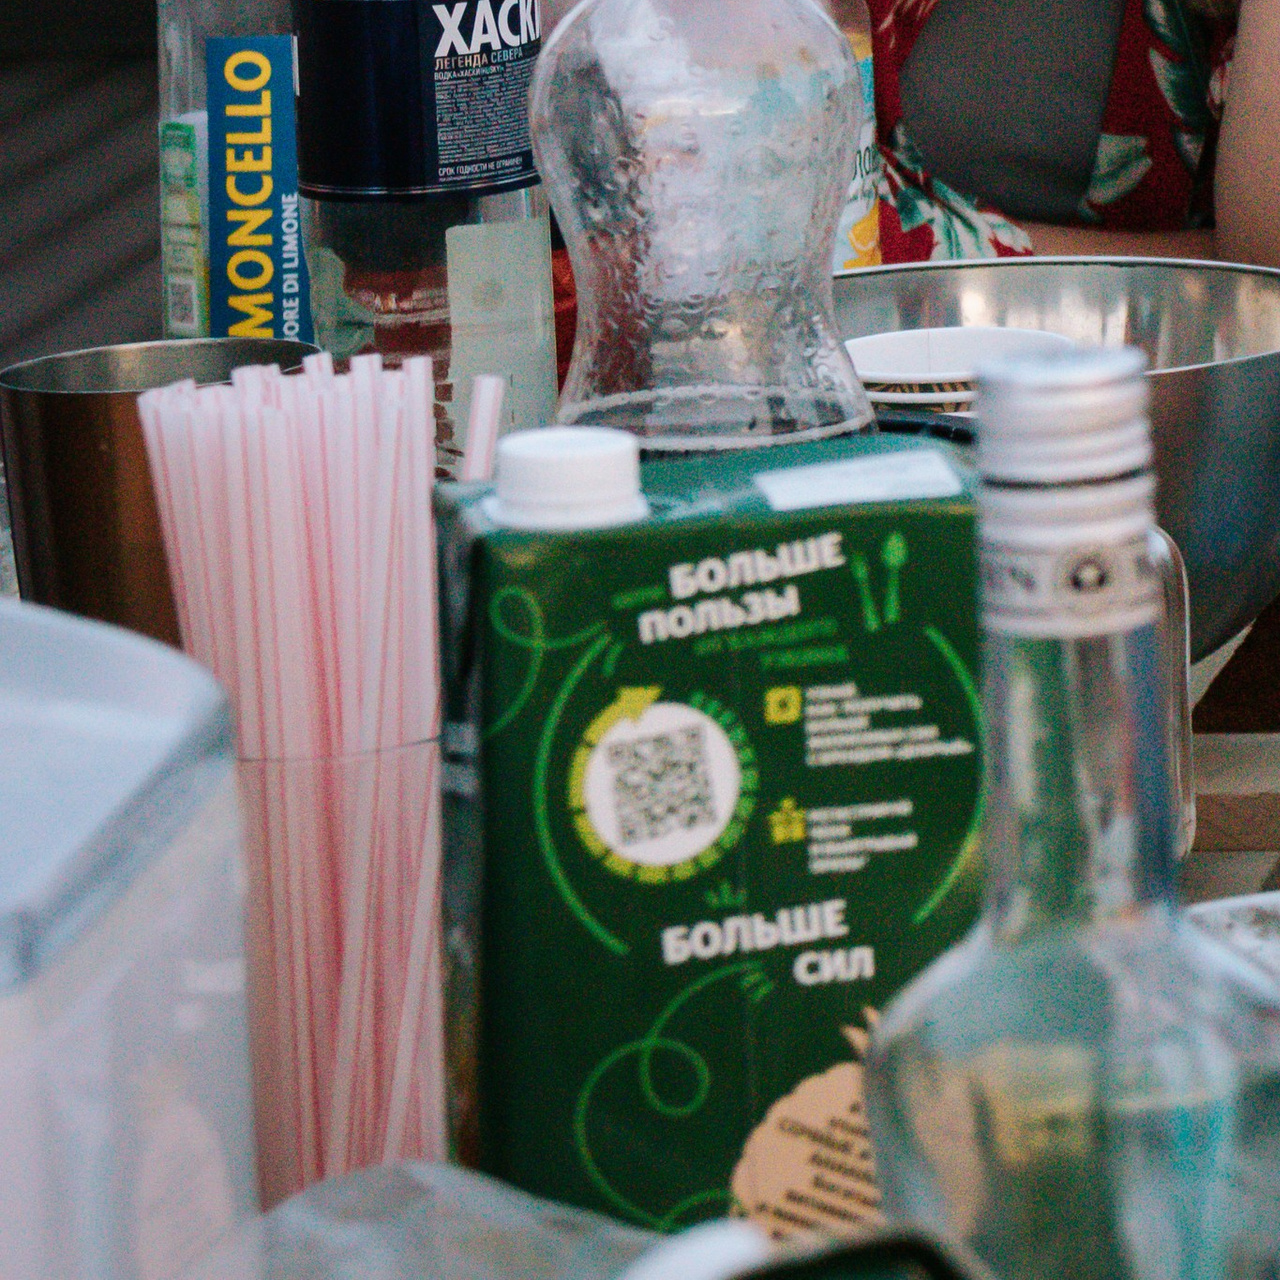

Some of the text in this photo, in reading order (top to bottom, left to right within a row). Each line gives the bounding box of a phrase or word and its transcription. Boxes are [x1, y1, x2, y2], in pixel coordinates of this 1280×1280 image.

[435, 46, 523, 71] ЛЕГЕНДА СЕВЕРА
[281, 191, 299, 269] LIMONE
[282, 272, 299, 294] DI
[668, 530, 847, 601] БОЛЬШЕ
[637, 583, 801, 645] ПОЛЬЗЫ
[661, 897, 849, 966] БОЛЬШЕ
[792, 944, 876, 986] СИЛ
